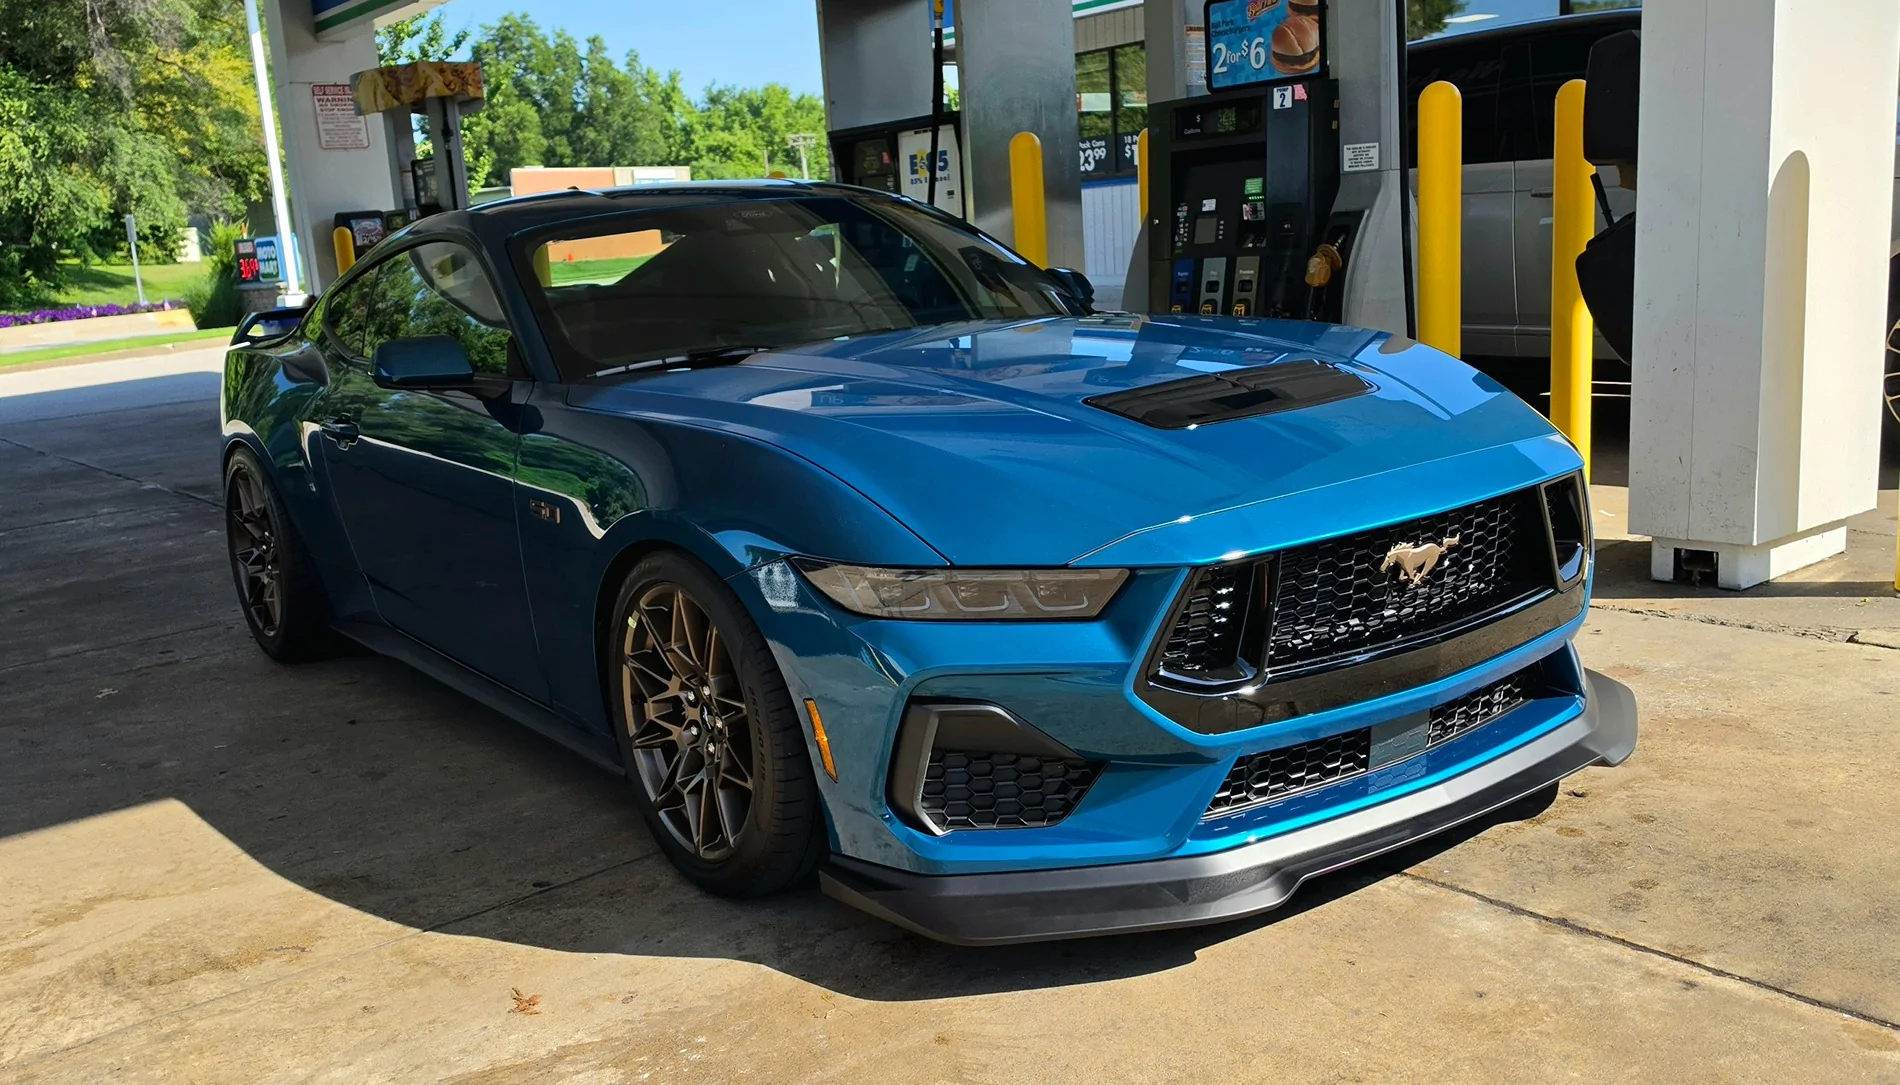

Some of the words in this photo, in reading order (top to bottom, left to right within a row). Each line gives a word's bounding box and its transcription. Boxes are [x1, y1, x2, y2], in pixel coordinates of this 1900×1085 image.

[1212, 42, 1228, 74] 2
[1227, 50, 1241, 64] for
[1279, 92, 1287, 108] 2
[256, 245, 276, 260] MOTO
